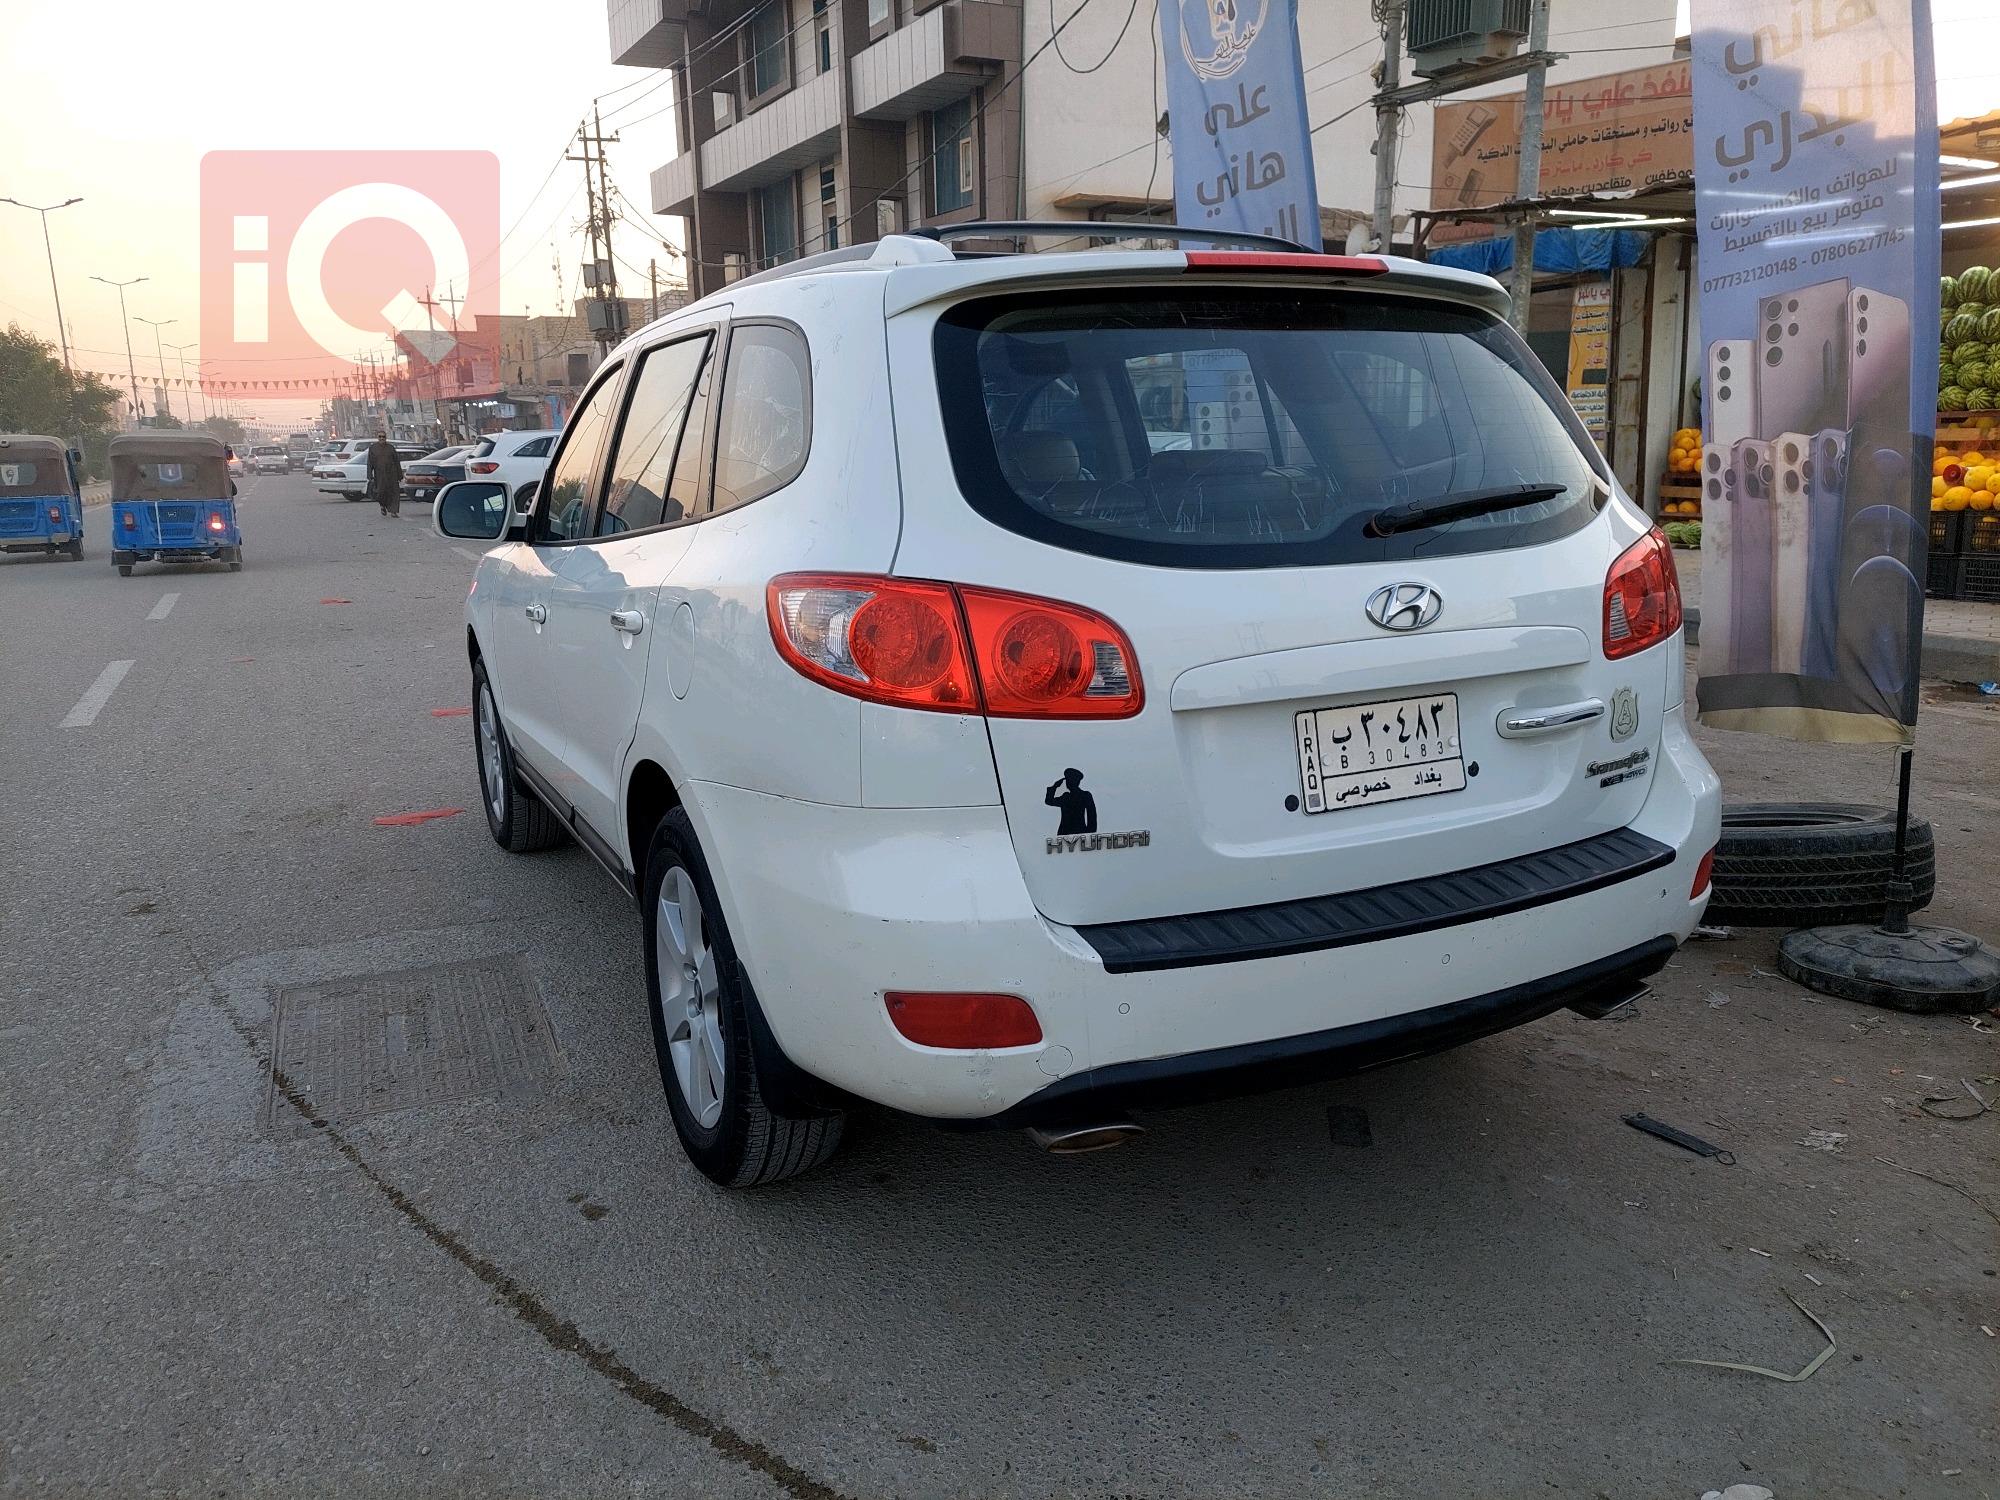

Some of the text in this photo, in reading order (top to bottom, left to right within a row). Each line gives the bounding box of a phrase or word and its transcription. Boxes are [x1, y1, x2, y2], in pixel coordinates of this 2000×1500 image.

[1204, 81, 1271, 149] علي
[1715, 50, 1896, 183] البدري
[1196, 150, 1286, 218] هاني
[1826, 157, 1897, 195] للهواتف
[1723, 195, 1884, 253] متوفر بيع بالتقسيط
[1303, 718, 1318, 790] IRAQ
[1340, 754, 1349, 769] B
[1335, 766, 1443, 803] بغداد خصوصي
[1046, 829, 1151, 854] HYUNDAI
